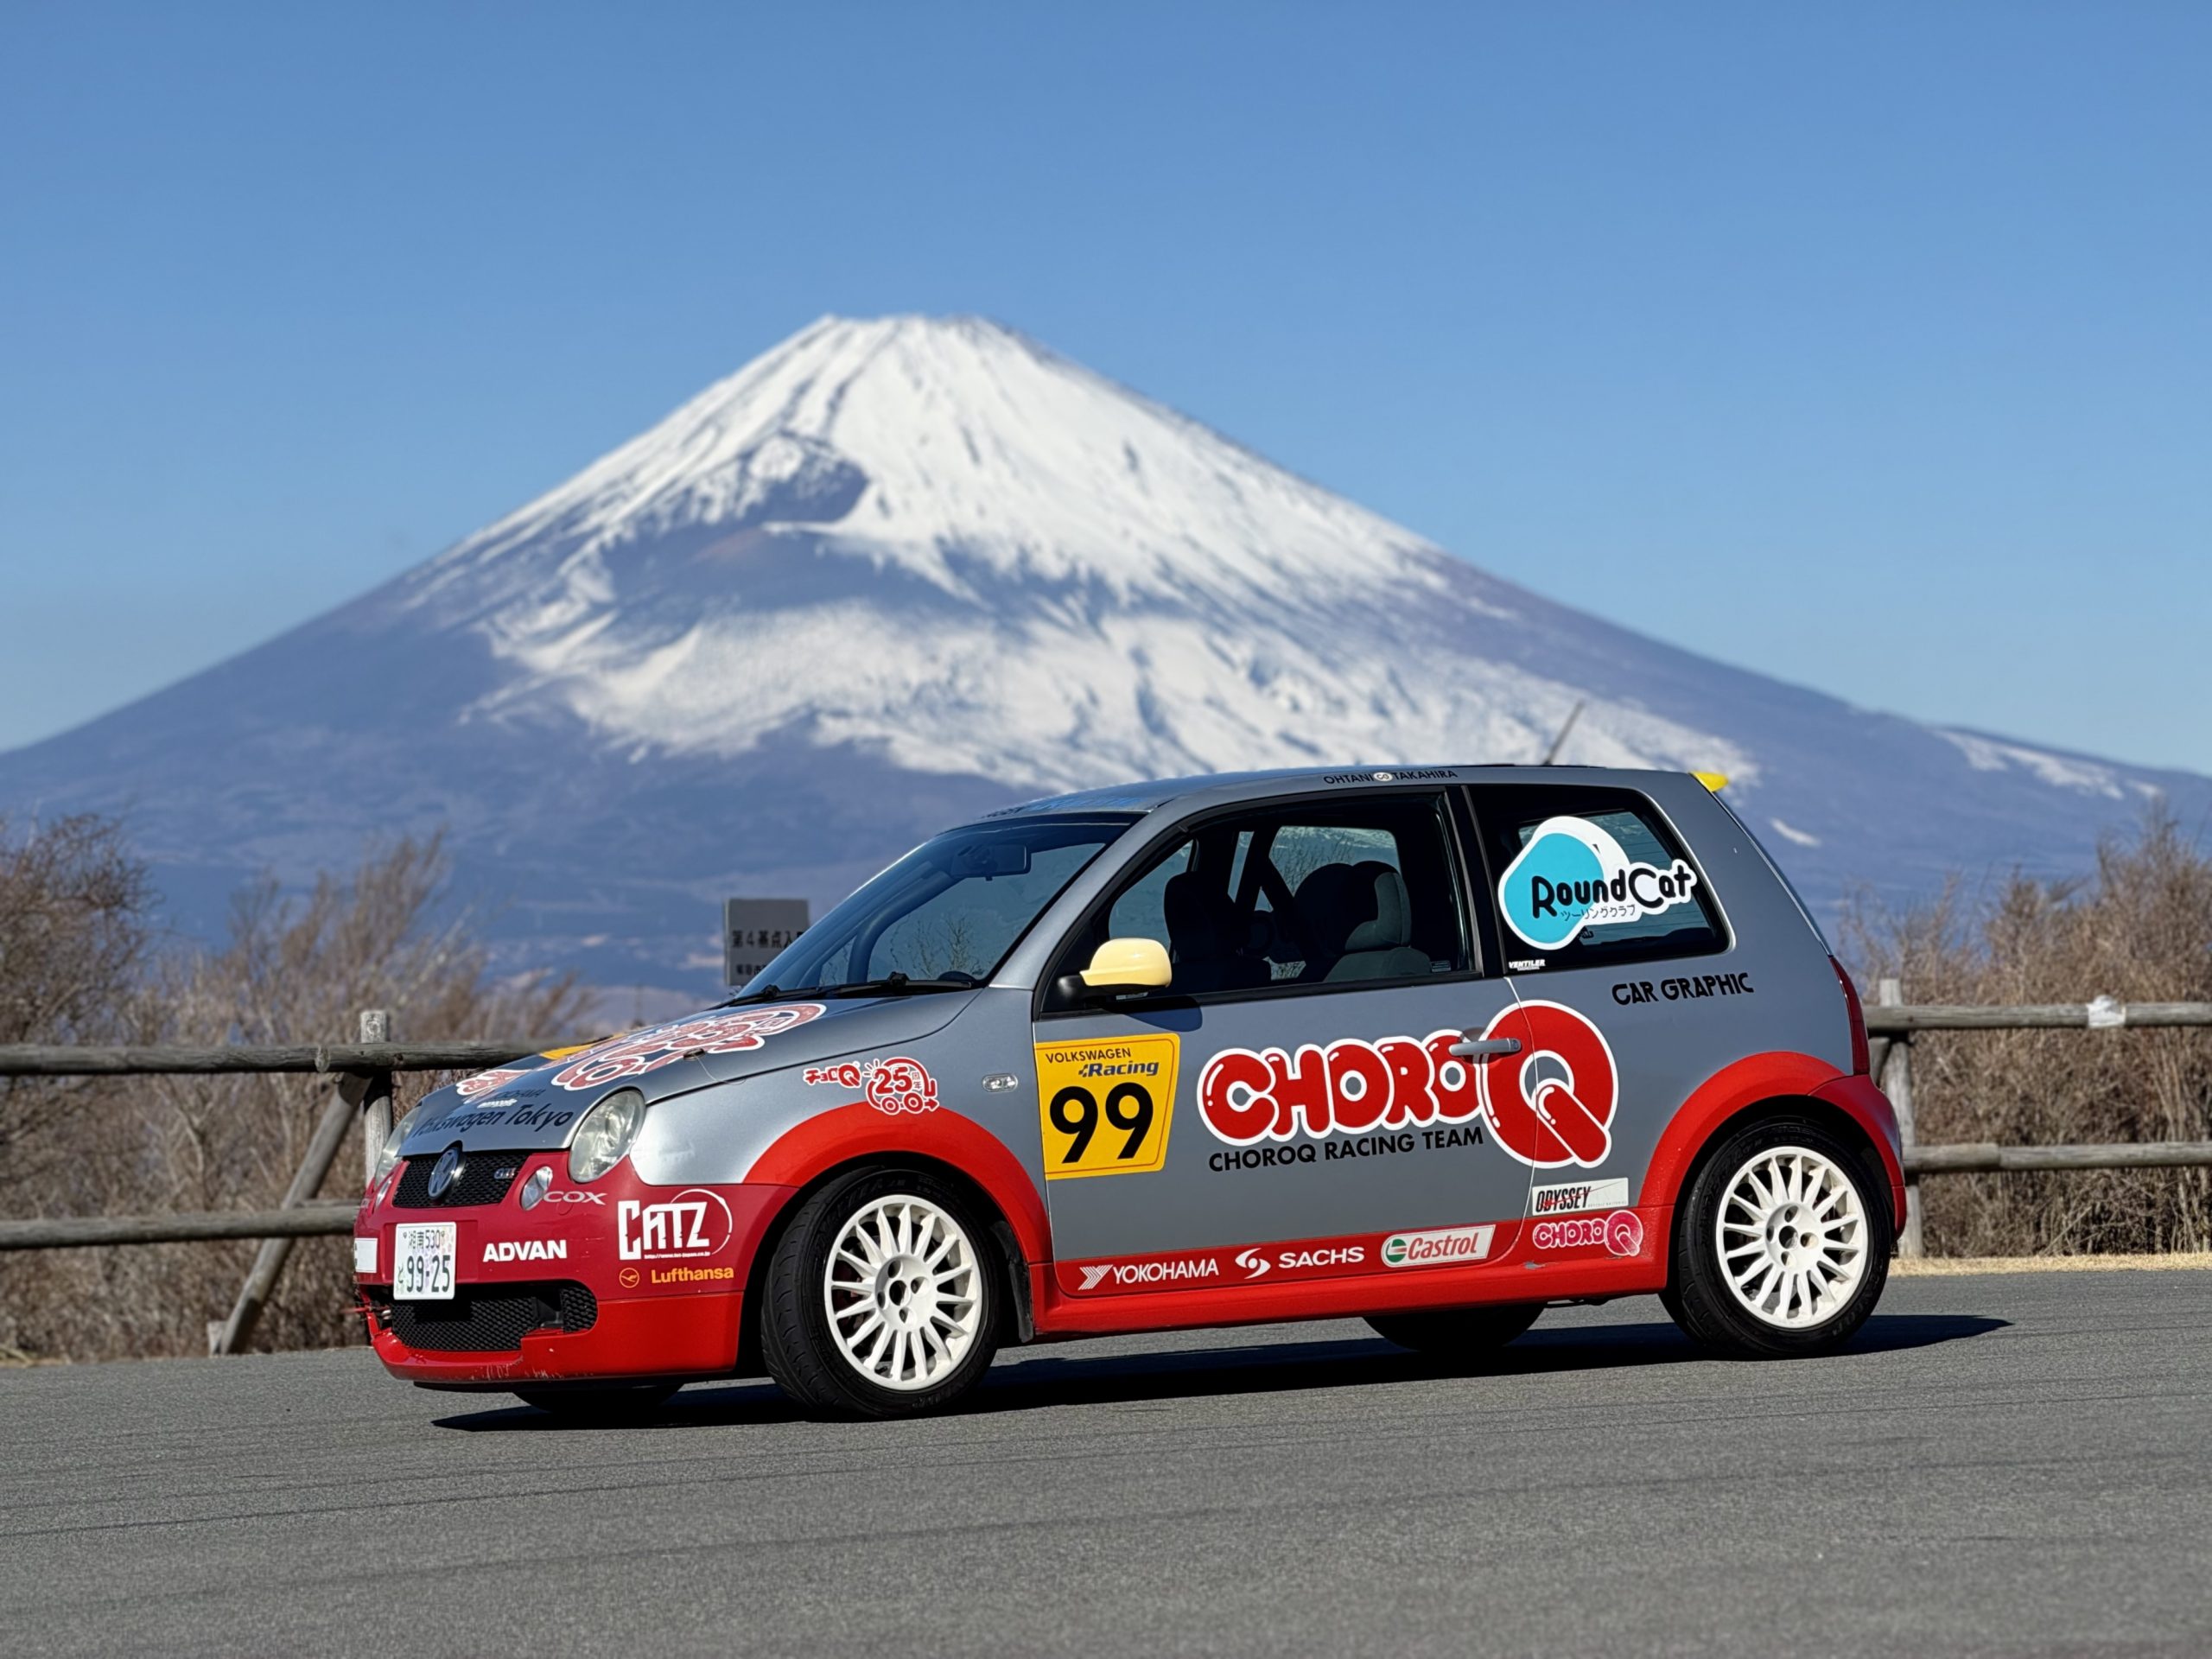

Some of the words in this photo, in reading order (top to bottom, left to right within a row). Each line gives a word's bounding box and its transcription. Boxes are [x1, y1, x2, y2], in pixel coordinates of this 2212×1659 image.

[1324, 773, 1375, 785] OHTANI
[1390, 770, 1459, 780] TAKAHIRA
[1560, 905, 1637, 922] ツーリングクラブ
[1611, 981, 1659, 1006] CAR
[1661, 972, 1755, 1001] GRAPHIC
[1046, 1047, 1132, 1065] VOLKSWAGEN
[1087, 1060, 1160, 1077] Racing
[873, 1065, 913, 1095] 25
[505, 1103, 575, 1133] Tokyo
[1049, 1082, 1154, 1164] 99
[1209, 1143, 1317, 1173] CHOROQ
[1325, 1133, 1415, 1160] RACING
[1421, 1126, 1484, 1150] TEAM
[543, 1191, 607, 1205] COX
[1535, 1186, 1592, 1213] ODYSSEY
[618, 1199, 710, 1261] CATZ
[1533, 1210, 1643, 1257] CHOROQ
[483, 1239, 568, 1262] ADVAN
[1278, 1246, 1365, 1269] SACHS
[1406, 1231, 1480, 1260] Castrol
[407, 1255, 451, 1294] 99-25
[651, 1267, 734, 1284] Lufthansa
[1113, 1257, 1219, 1285] YOKOHAMA
